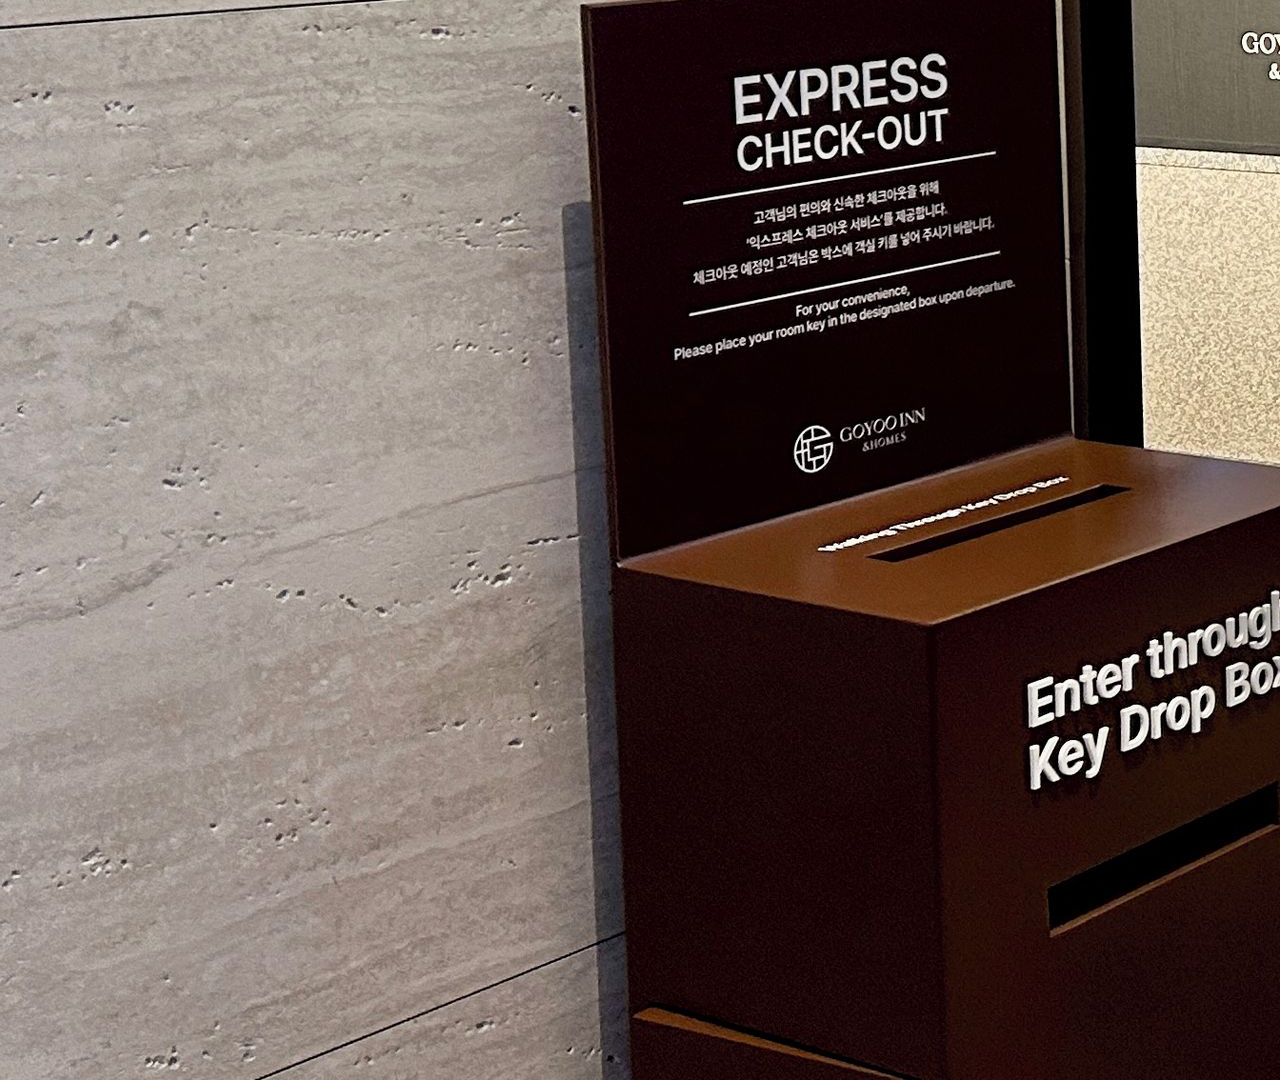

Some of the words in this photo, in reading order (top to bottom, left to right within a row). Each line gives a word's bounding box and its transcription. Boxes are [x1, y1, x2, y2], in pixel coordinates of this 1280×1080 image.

[734, 53, 948, 125] EXPRESS
[736, 108, 949, 171] CHECK-OUT
[753, 204, 797, 224] 고객님의
[799, 198, 832, 217] 편의와
[833, 193, 865, 212] 신속한
[866, 184, 917, 205] 체크아웃을
[919, 180, 940, 196] 위해
[805, 220, 848, 240] 체크아웃
[692, 264, 739, 285] 체크아웃
[740, 257, 774, 275] 예정인
[821, 241, 853, 261] 박스에
[855, 237, 876, 253] 객실
[877, 233, 899, 250] 키를
[900, 229, 921, 247] 넣어
[922, 223, 952, 241] 주시기
[674, 343, 713, 361] Please
[715, 335, 747, 355] place
[748, 329, 774, 348] your
[776, 323, 805, 339] room
[806, 319, 826, 333] key
[827, 316, 838, 328] in
[840, 311, 858, 325] the
[859, 297, 917, 322] designated
[918, 294, 938, 308] box
[939, 289, 965, 305] upon
[965, 278, 1016, 298] departure.
[795, 305, 813, 317] For
[815, 299, 840, 316] your
[841, 285, 910, 308] convenience,
[839, 415, 897, 442] GOYOO
[899, 407, 926, 428] INN
[862, 431, 907, 452] &HOMES
[1027, 653, 1140, 728] Enter
[1028, 726, 1110, 791] Key
[1119, 685, 1216, 752] Drop
